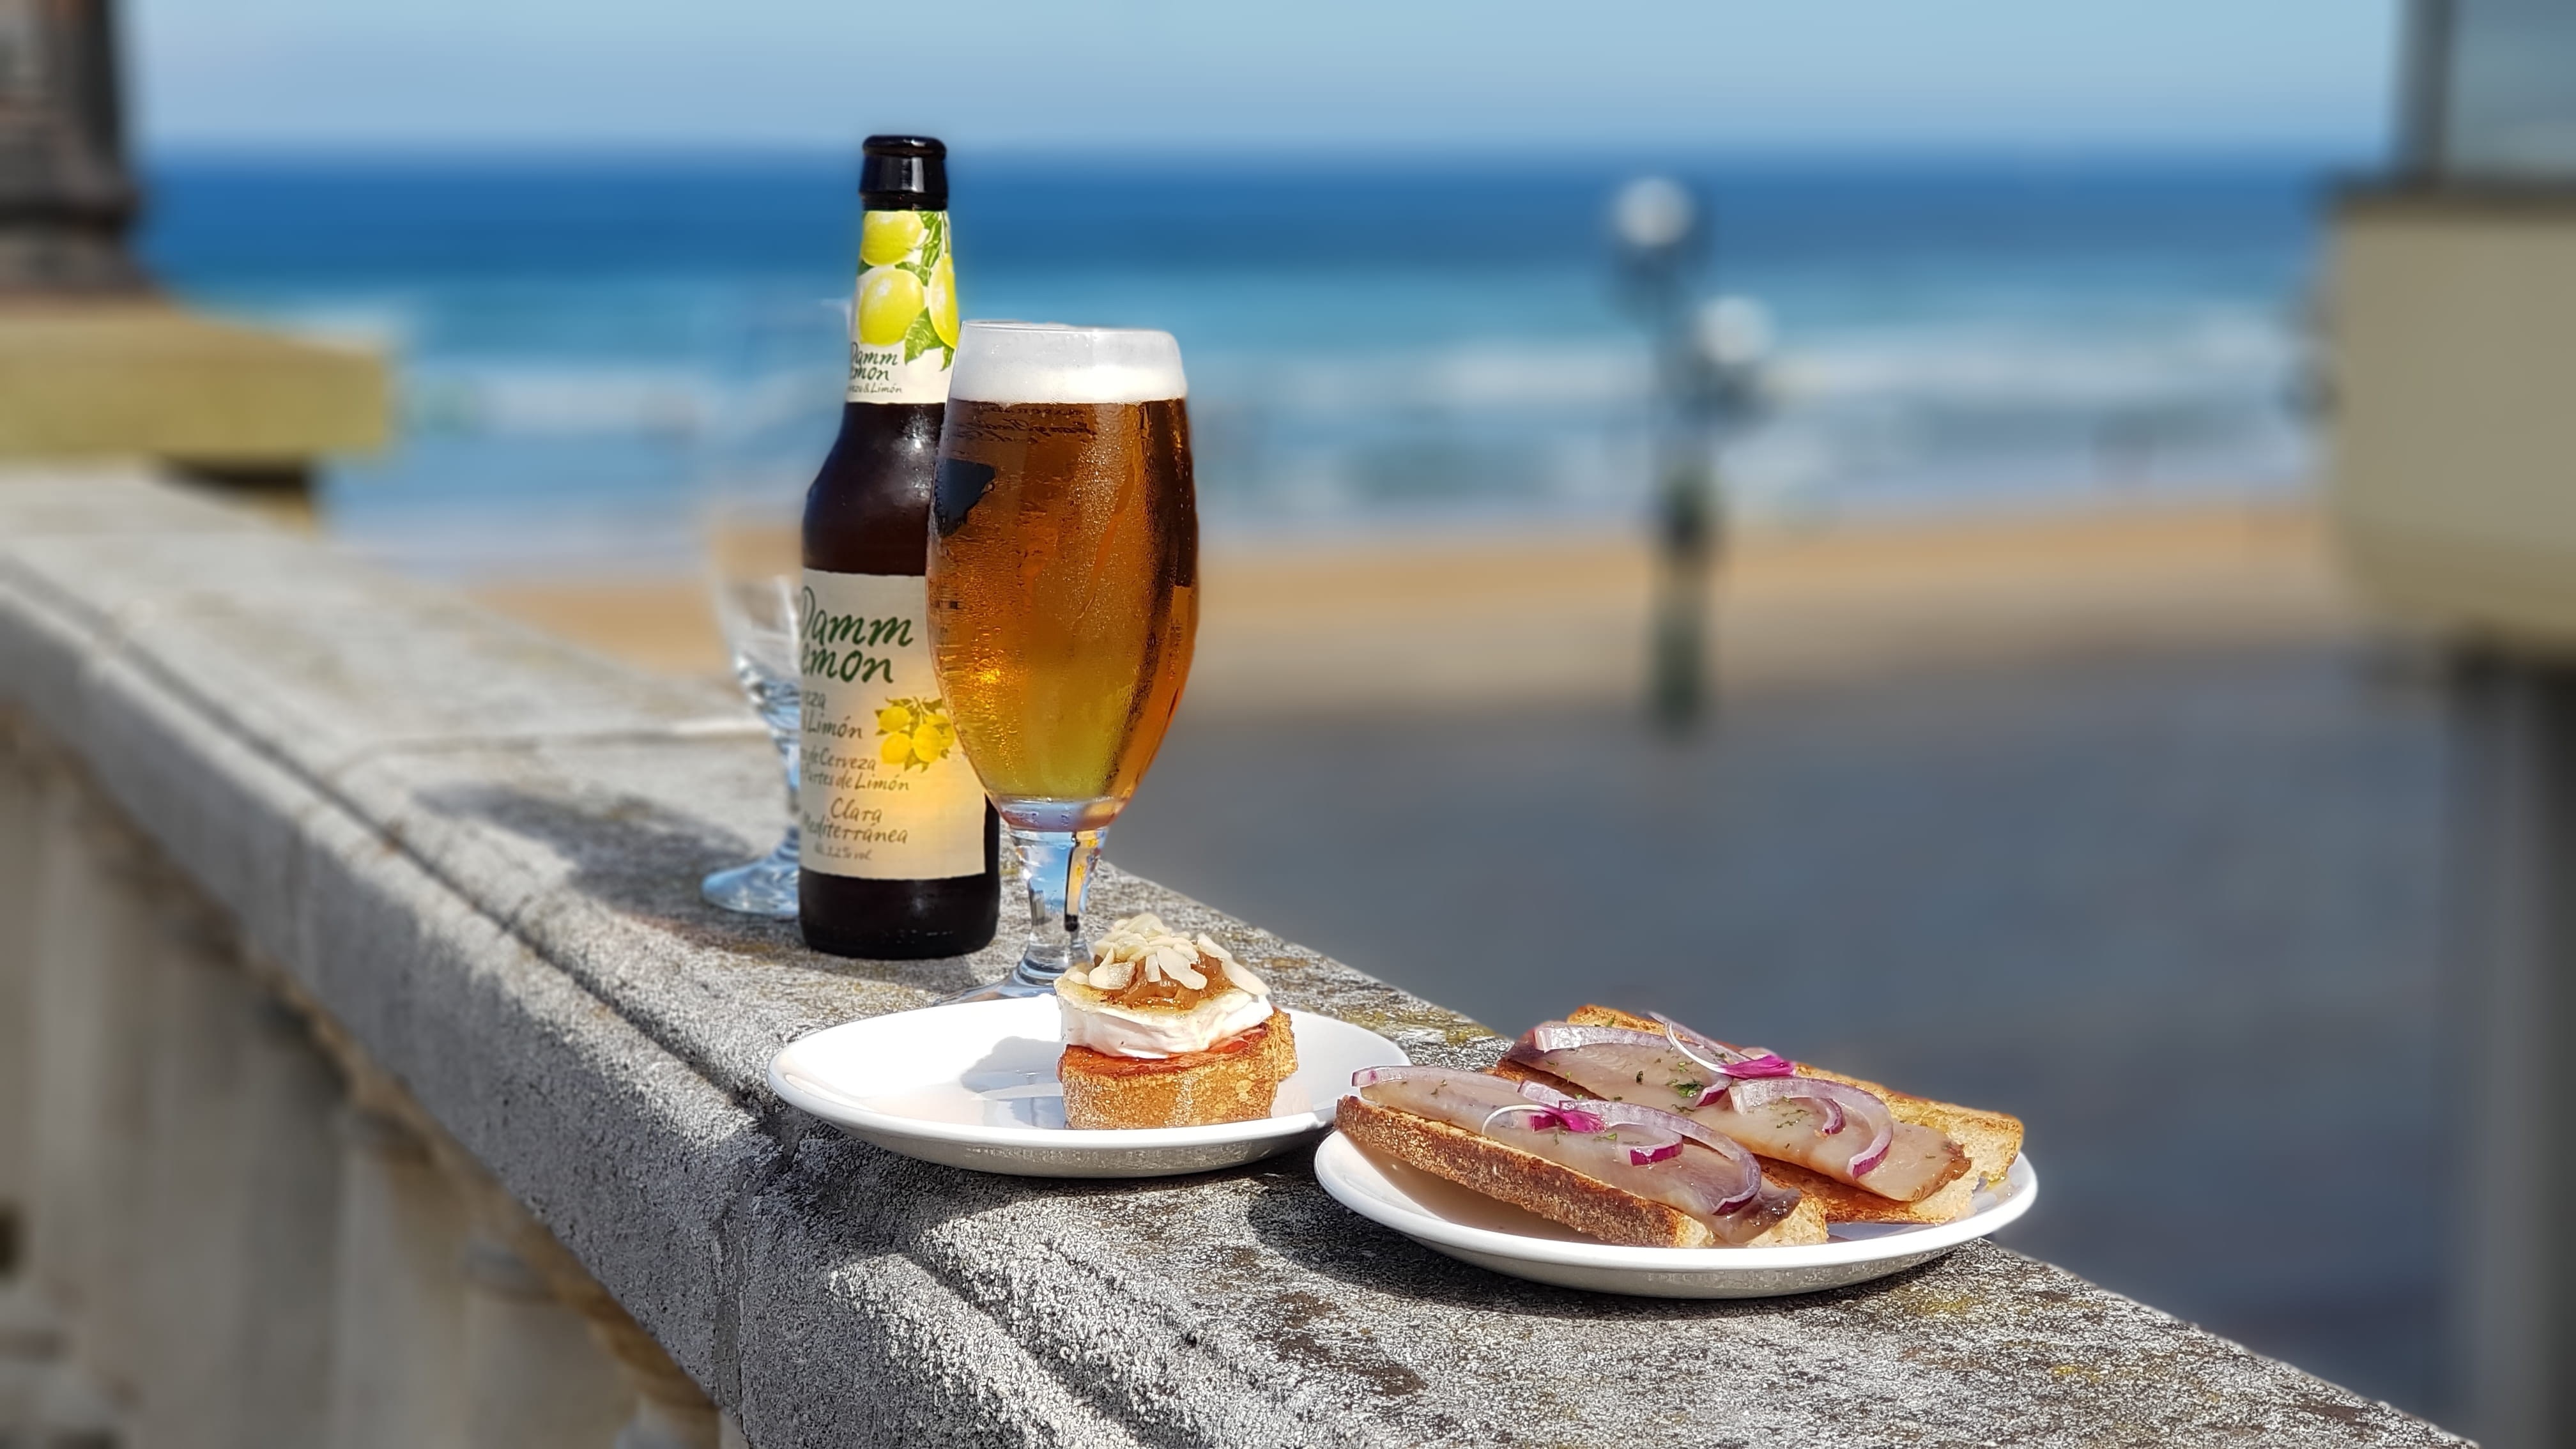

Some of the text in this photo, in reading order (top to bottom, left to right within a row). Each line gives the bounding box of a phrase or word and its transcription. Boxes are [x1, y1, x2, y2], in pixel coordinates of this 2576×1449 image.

[801, 585, 914, 647] Damm
[801, 642, 894, 684] emon
[808, 709, 863, 739] Limón
[820, 746, 876, 770] Cerveza
[836, 769, 852, 790] de
[855, 772, 909, 791] Limón
[831, 797, 883, 823] Clara
